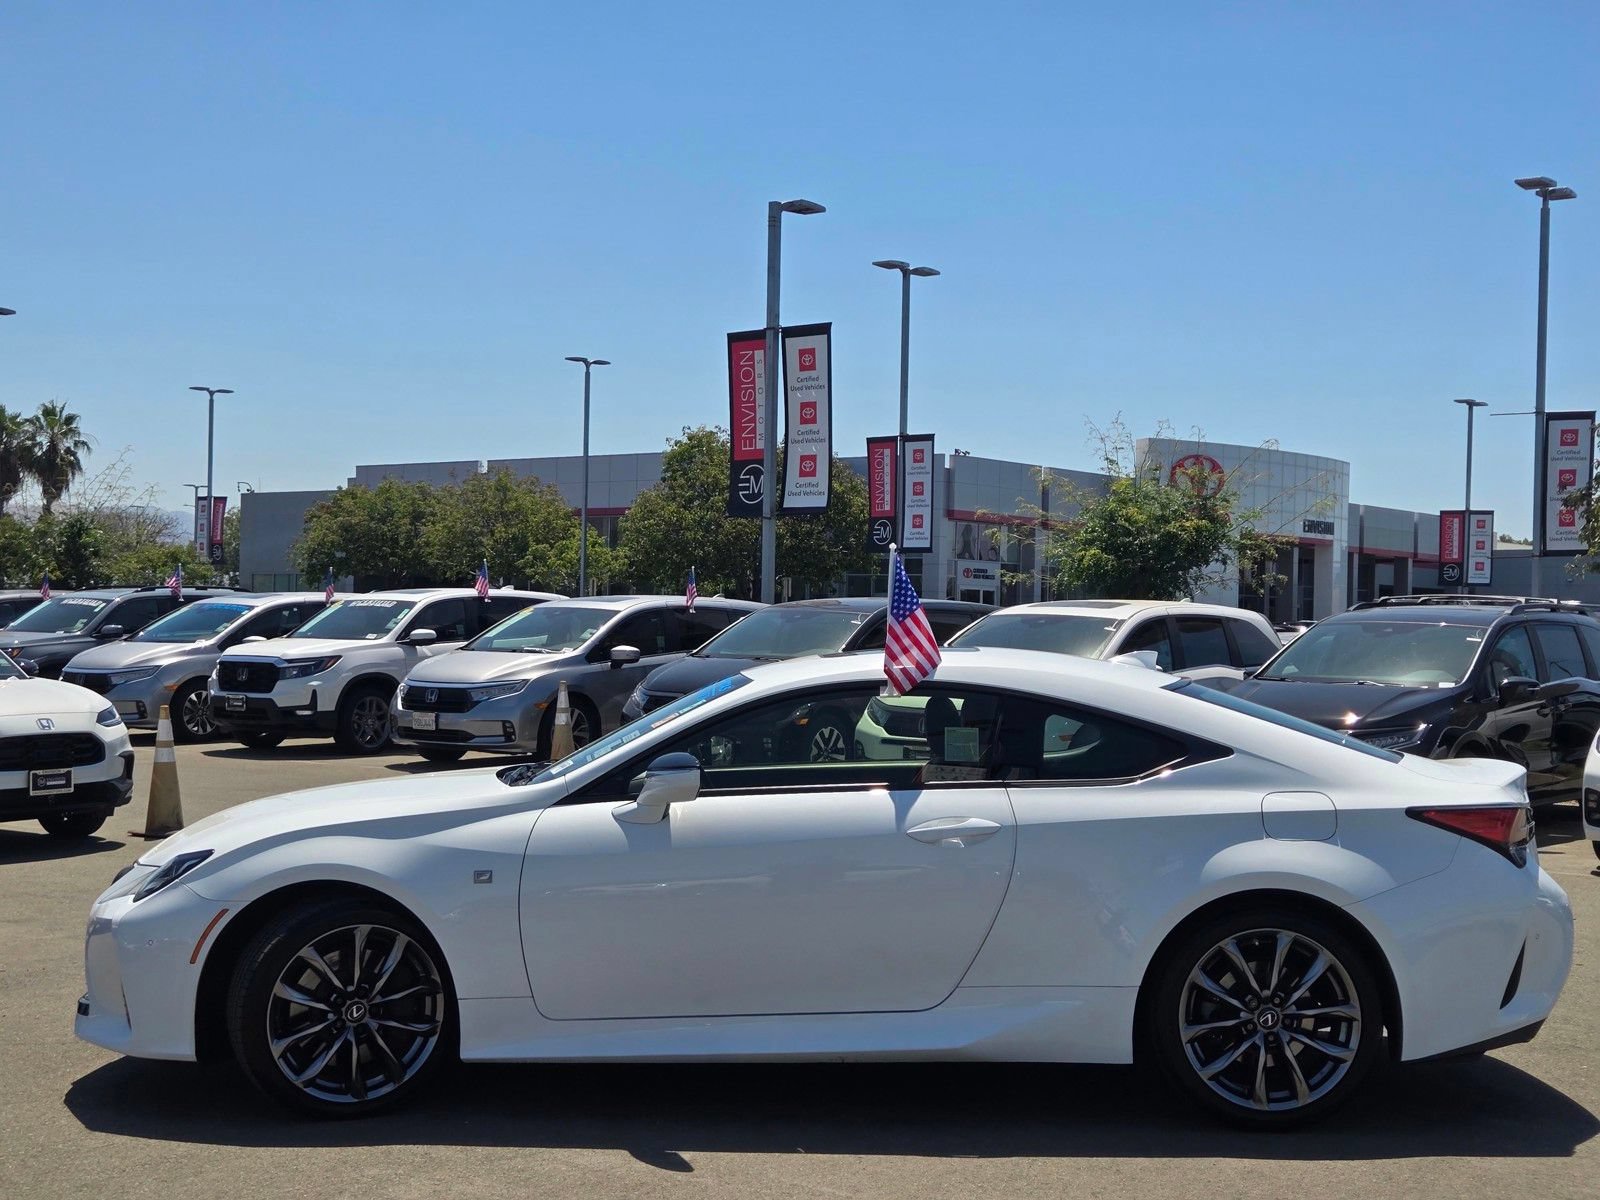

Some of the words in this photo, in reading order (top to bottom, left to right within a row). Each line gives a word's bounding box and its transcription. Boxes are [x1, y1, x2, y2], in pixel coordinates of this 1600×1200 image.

[740, 350, 756, 451] ENVISION
[757, 359, 765, 441] MOTORS
[874, 448, 884, 512] ENVISION
[1444, 517, 1453, 559] ENVISION
